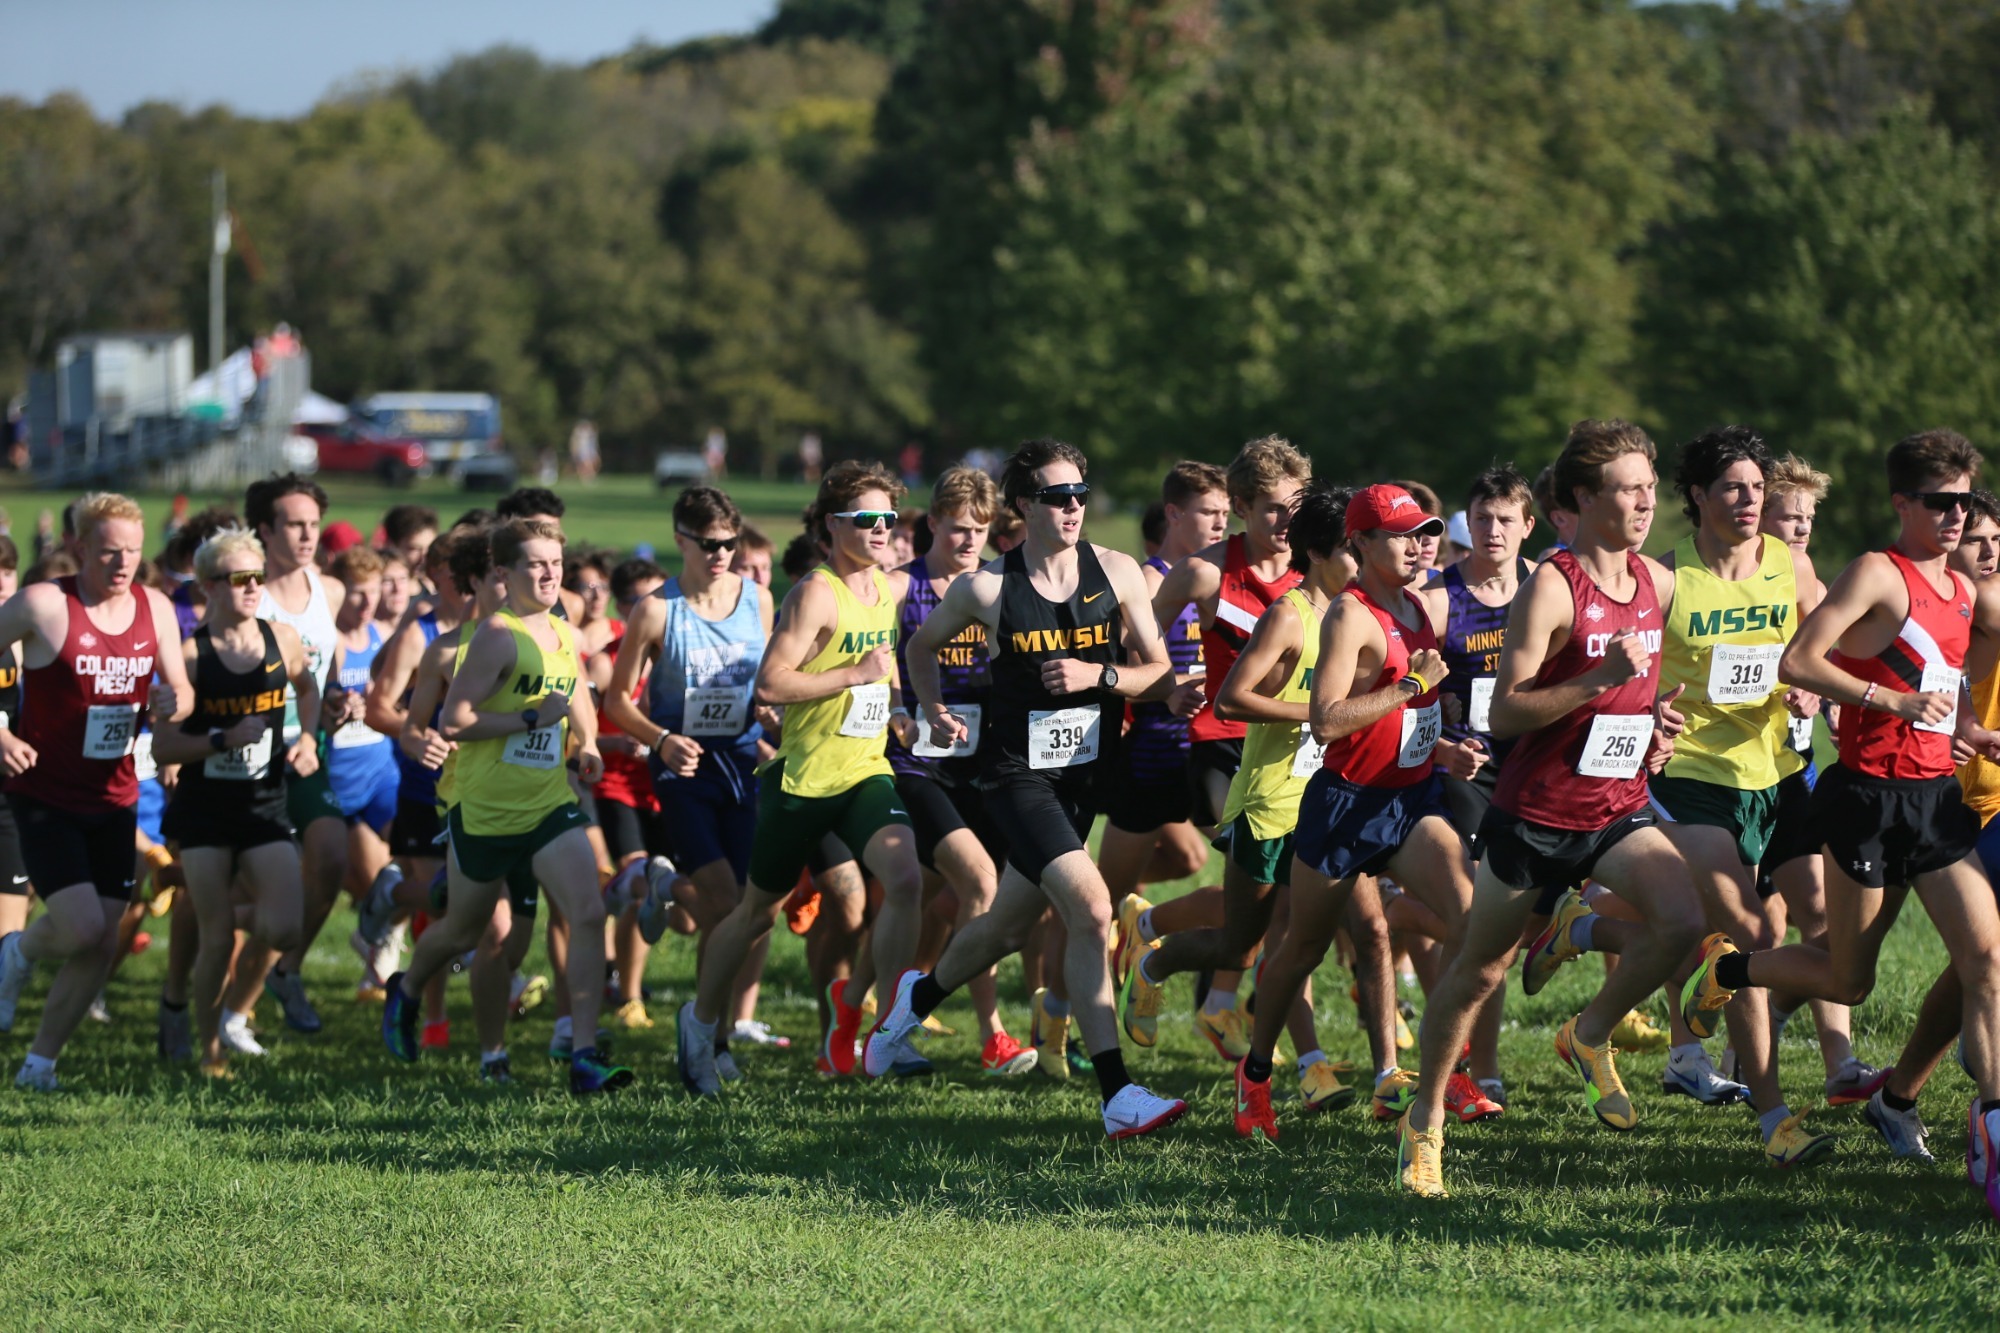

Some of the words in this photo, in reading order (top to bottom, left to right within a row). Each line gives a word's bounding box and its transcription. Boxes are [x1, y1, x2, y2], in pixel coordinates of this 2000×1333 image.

[1688, 604, 1788, 637] MSSU
[838, 629, 897, 654] MSSU
[1012, 622, 1110, 653] MWSU
[76, 654, 153, 677] COLORADO
[1736, 652, 1770, 661] PRE-NATIONALS
[1730, 663, 1763, 685] 319
[94, 676, 136, 695] MESA
[513, 674, 576, 698] MSSU
[1719, 686, 1731, 695] RIM
[1732, 686, 1749, 695] ROCK
[1750, 684, 1767, 694] FARM
[204, 687, 287, 714] MWSU
[700, 703, 732, 720] 427
[862, 702, 884, 721] 318
[1052, 714, 1087, 726] PRE-NATIONALS
[102, 722, 130, 742] 253
[524, 731, 552, 751] 317
[1049, 726, 1084, 749] 339
[1417, 721, 1437, 747] 345
[1041, 751, 1054, 760] RIM
[1056, 749, 1073, 760] ROCK
[1073, 745, 1091, 757] FARM
[1602, 736, 1637, 757] 256
[1590, 758, 1604, 768] RIM
[1604, 759, 1620, 769] ROCK
[1621, 760, 1638, 769] FARM
